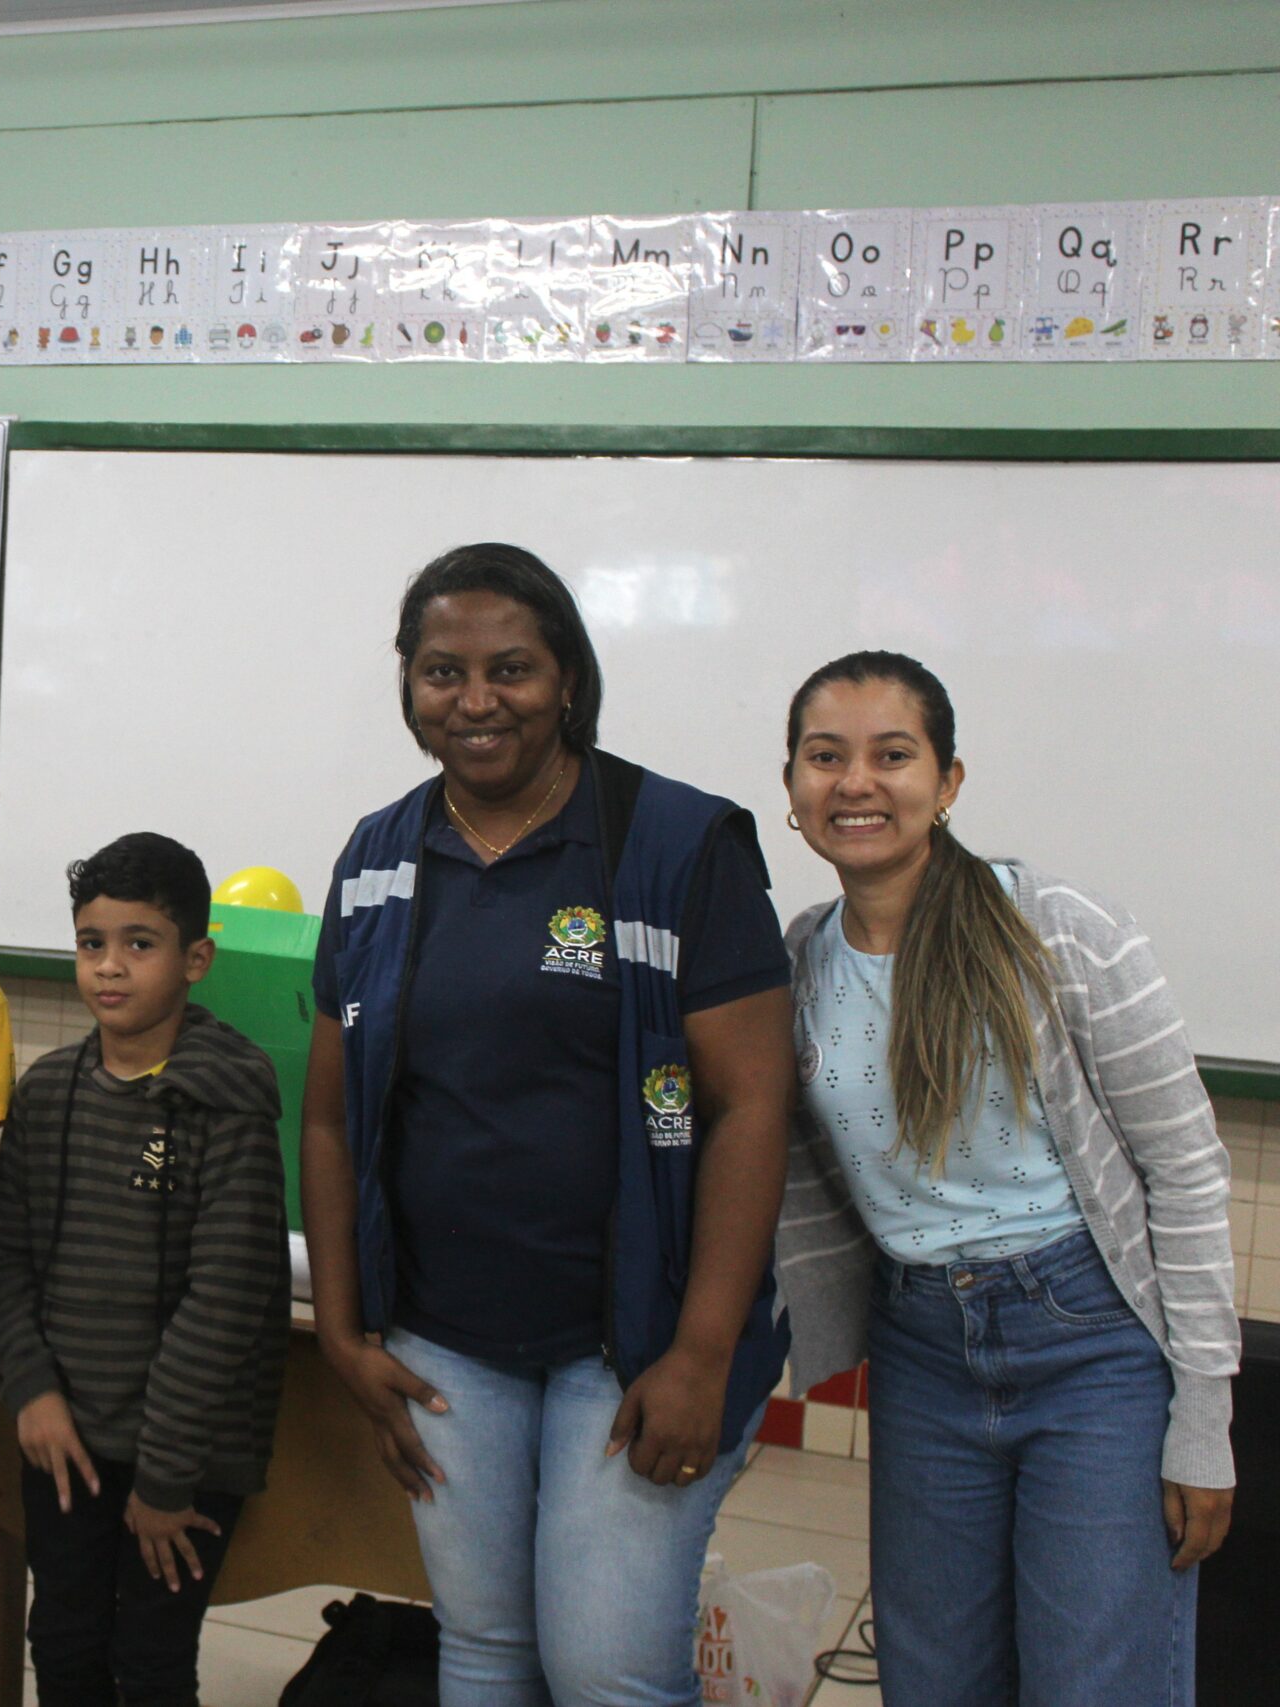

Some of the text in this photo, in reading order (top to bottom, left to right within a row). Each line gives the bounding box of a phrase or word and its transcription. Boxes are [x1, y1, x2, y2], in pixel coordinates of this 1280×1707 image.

[53, 250, 92, 285] Gg
[140, 247, 179, 275] Hh
[721, 233, 769, 265] Nn
[831, 232, 880, 263] Oo
[945, 229, 994, 270] Pp
[1058, 226, 1117, 267] Qq
[1180, 222, 1233, 256] Rr
[545, 947, 604, 965] ACRE
[646, 1115, 692, 1130] ACRE
